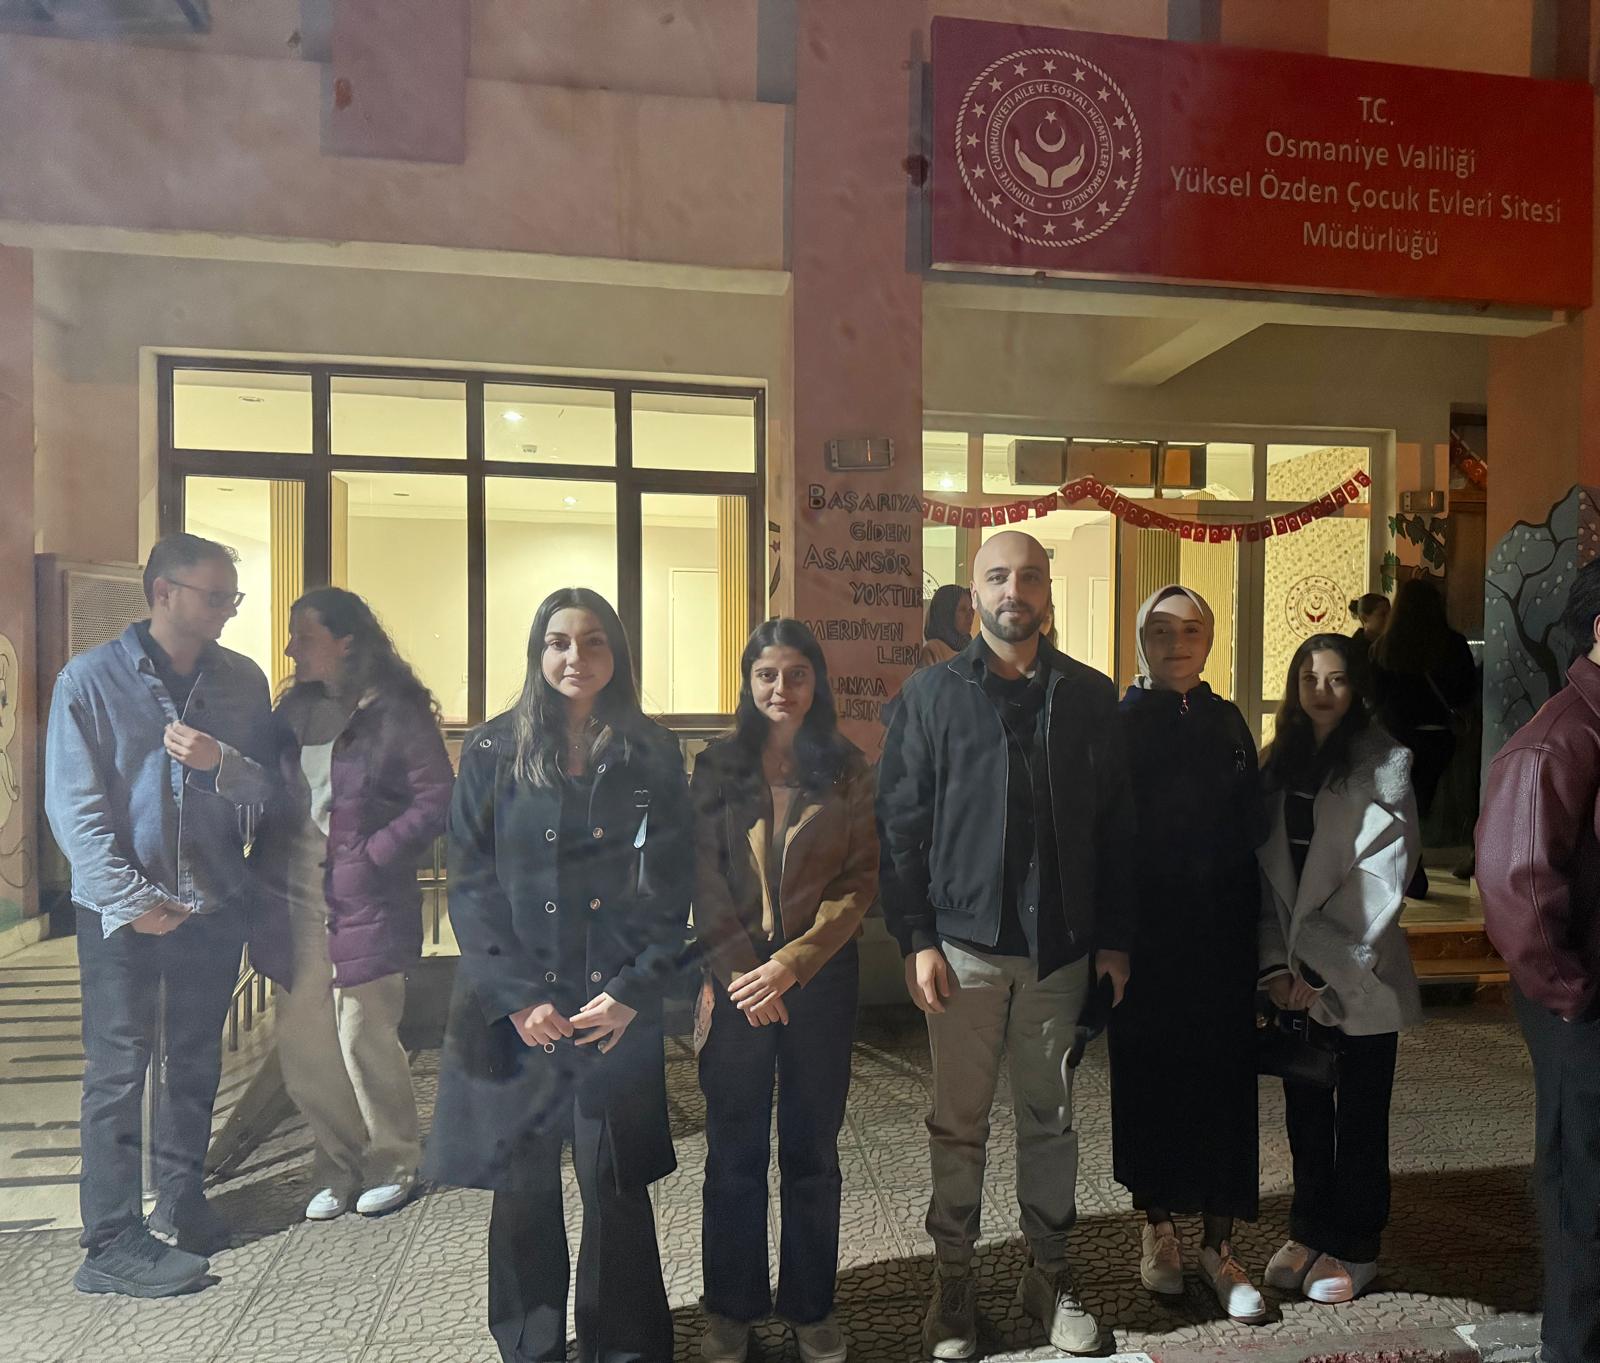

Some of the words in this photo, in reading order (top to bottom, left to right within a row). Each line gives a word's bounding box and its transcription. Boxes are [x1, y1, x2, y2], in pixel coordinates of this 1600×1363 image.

[990, 96, 1015, 170] CUMHURİYETİ
[1014, 85, 1035, 103] AİLE
[1036, 83, 1050, 94] VE
[1051, 84, 1089, 111] SOSYAL
[1087, 107, 1110, 169] HİZMETLER
[1358, 96, 1394, 126] T.C.
[1265, 131, 1389, 171] Osmaniye
[1397, 143, 1476, 179] Valiliği
[1170, 165, 1250, 197] Yüksel
[1260, 167, 1338, 204] Özden
[1347, 182, 1420, 213] Çocuk
[1428, 188, 1492, 218] Evleri
[1501, 194, 1561, 224] Sitesi
[1303, 221, 1439, 260] Müdürlüğü
[808, 483, 923, 514] BAŞARIYA
[850, 519, 912, 543] GİDEN
[803, 544, 912, 577] ASANSÖR
